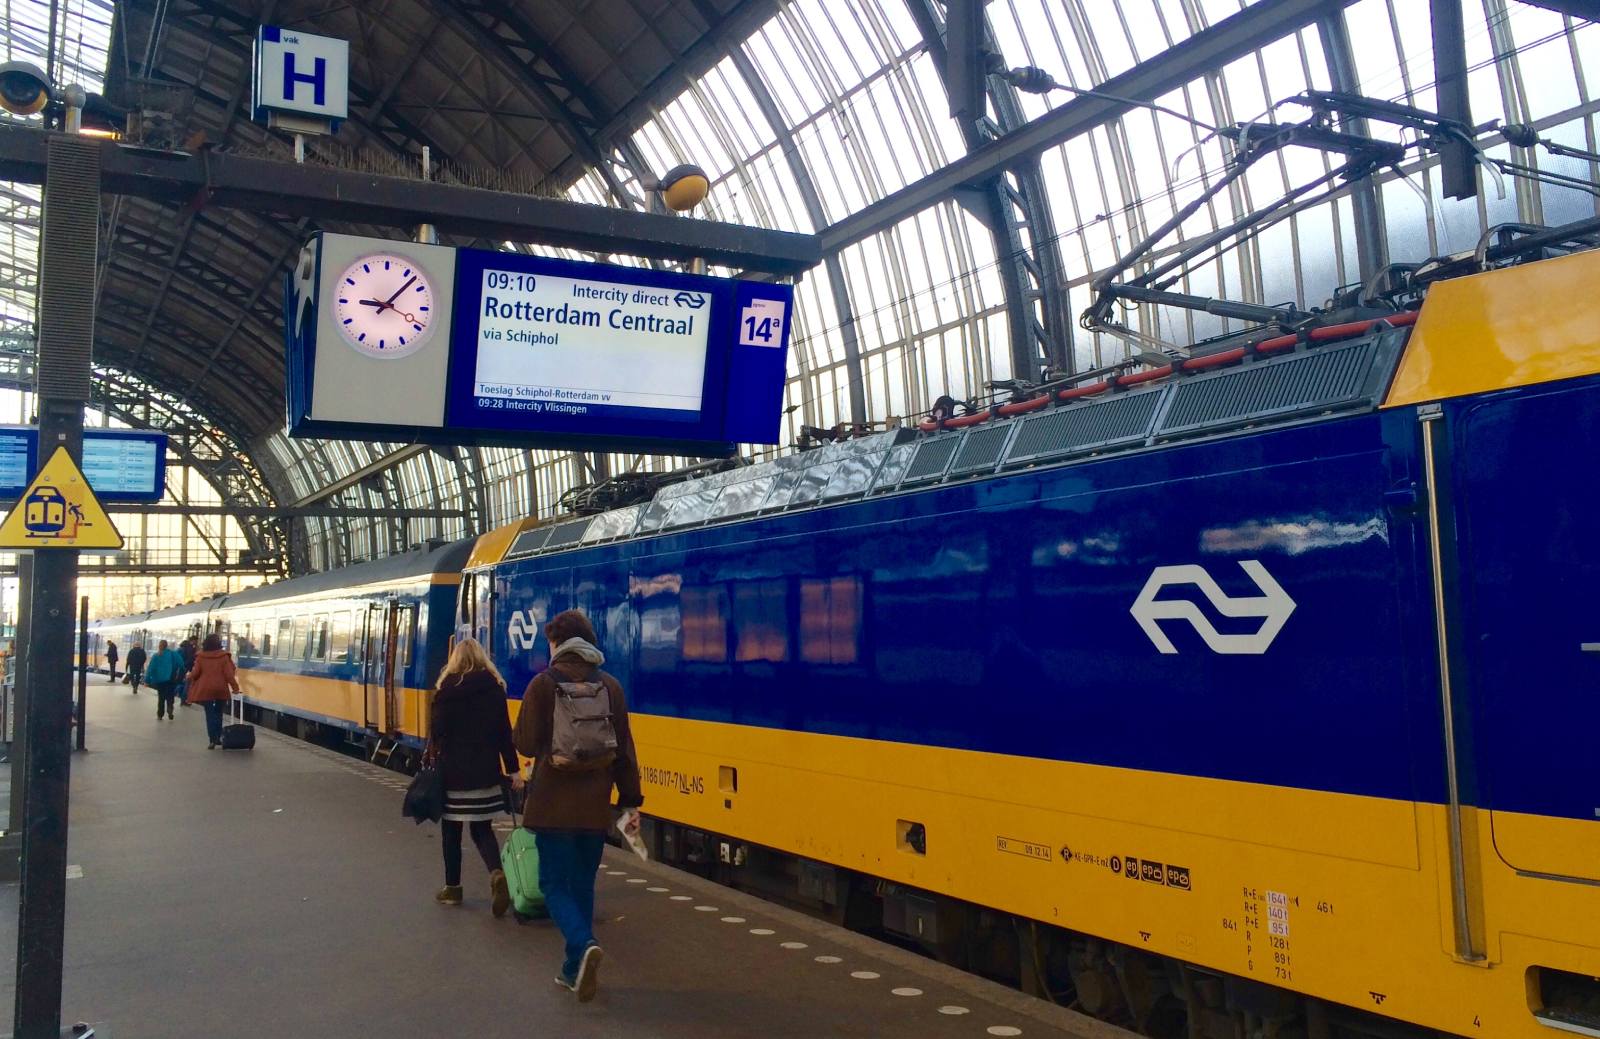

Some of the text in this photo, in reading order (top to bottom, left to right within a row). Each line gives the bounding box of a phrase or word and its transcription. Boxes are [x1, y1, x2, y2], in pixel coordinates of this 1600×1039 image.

[283, 36, 299, 45] vak
[283, 51, 326, 106] H
[487, 272, 536, 293] 09:10
[573, 284, 669, 306] Intercity direct
[485, 297, 693, 335] Rotterdam Centraal
[483, 328, 559, 346] via Schiphol
[480, 384, 513, 397] Toeslag
[478, 398, 587, 414] 09:28 Intercity Vlissingen
[1473, 1015, 1481, 1028] 4
